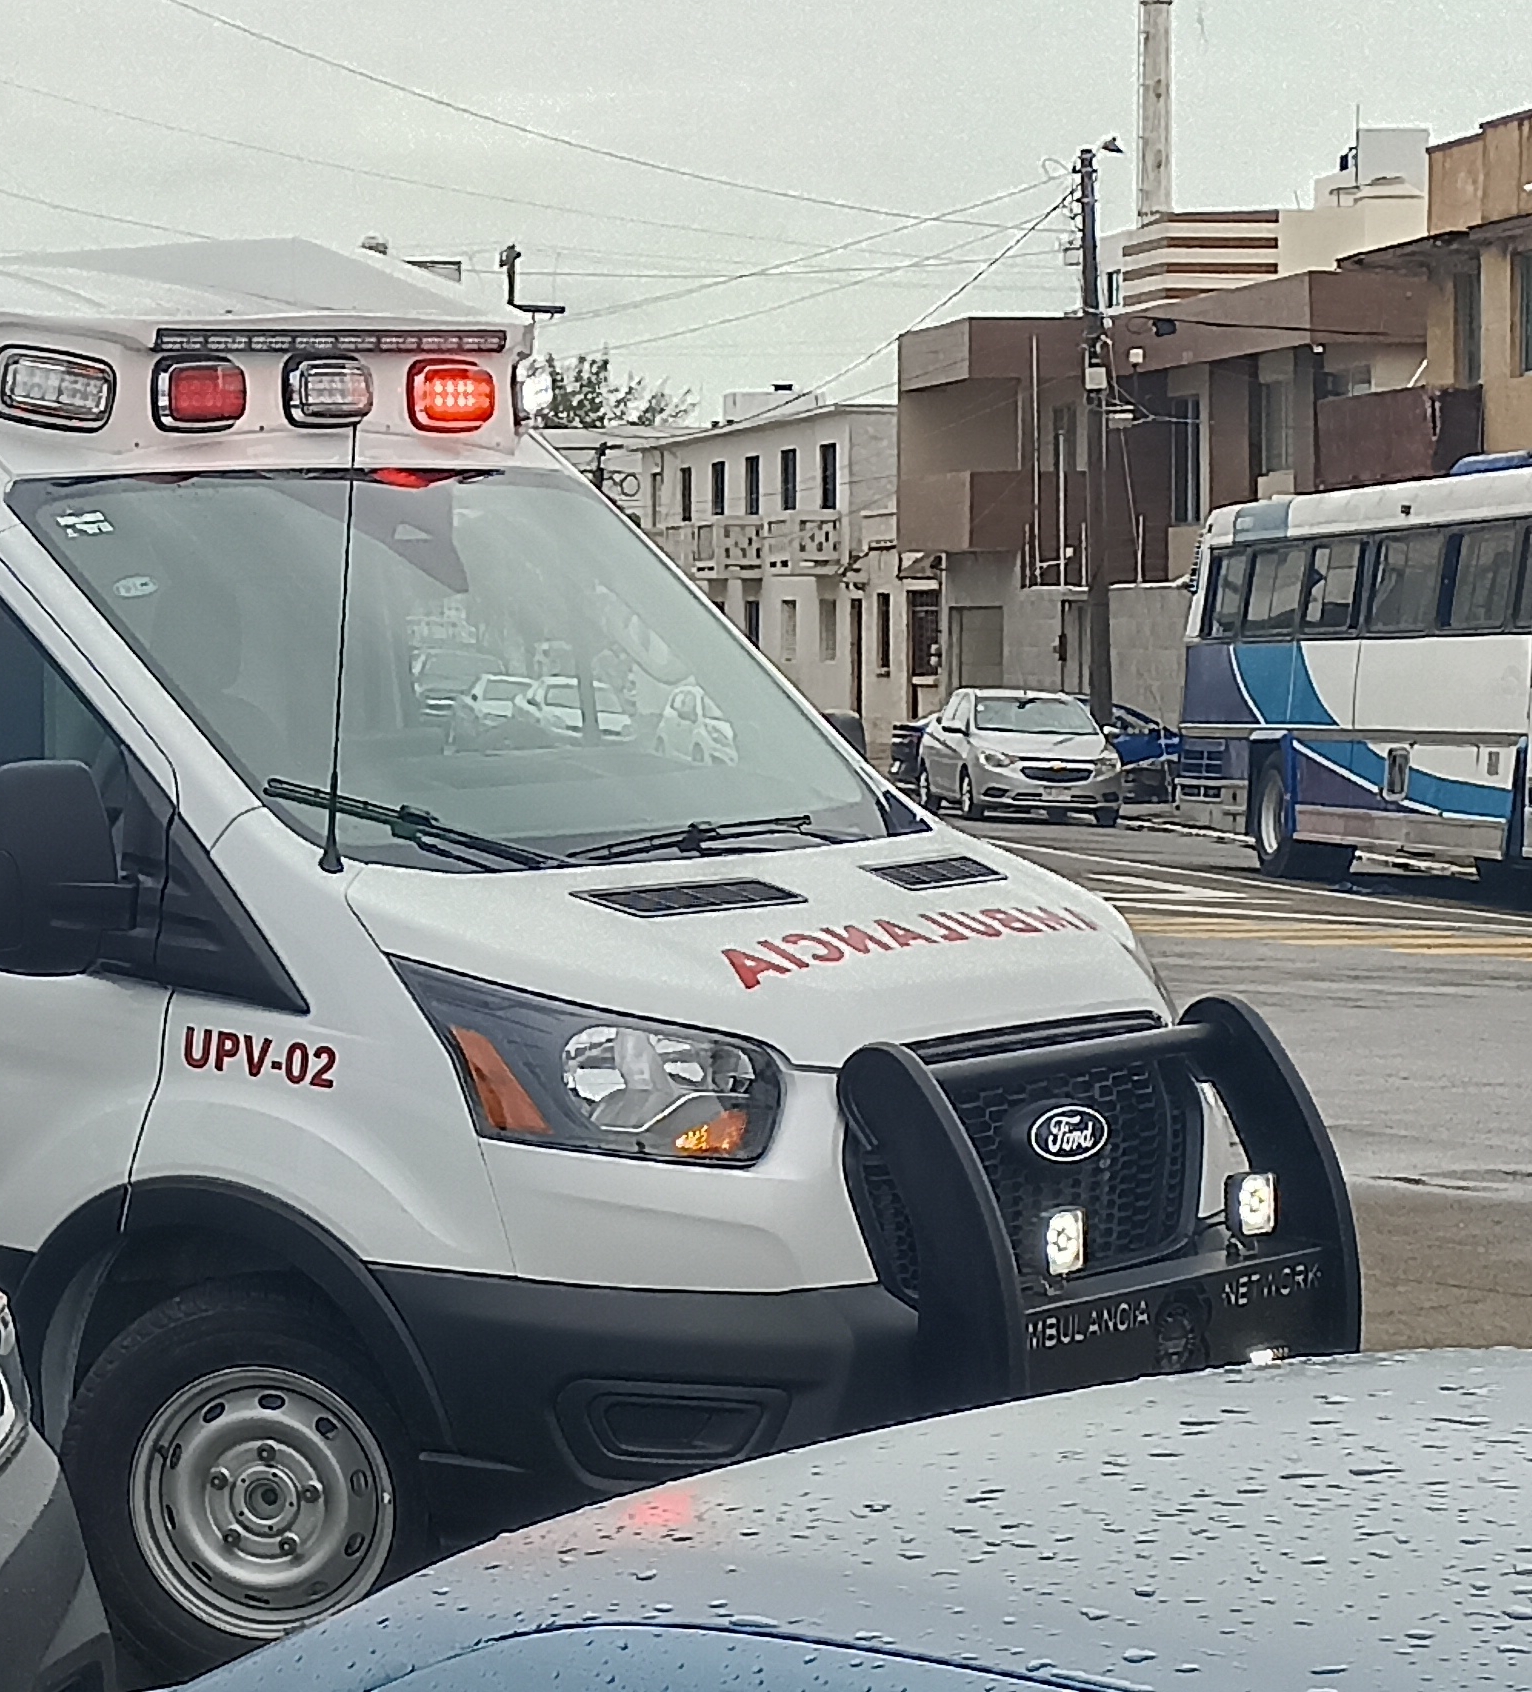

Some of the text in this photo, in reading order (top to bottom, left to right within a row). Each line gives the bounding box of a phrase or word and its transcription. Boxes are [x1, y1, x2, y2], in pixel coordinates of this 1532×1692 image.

[183, 1025, 337, 1089] UPV-02
[1048, 1114, 1095, 1153] Ford
[1025, 1263, 1320, 1351] MBULANCIA NETWORK
